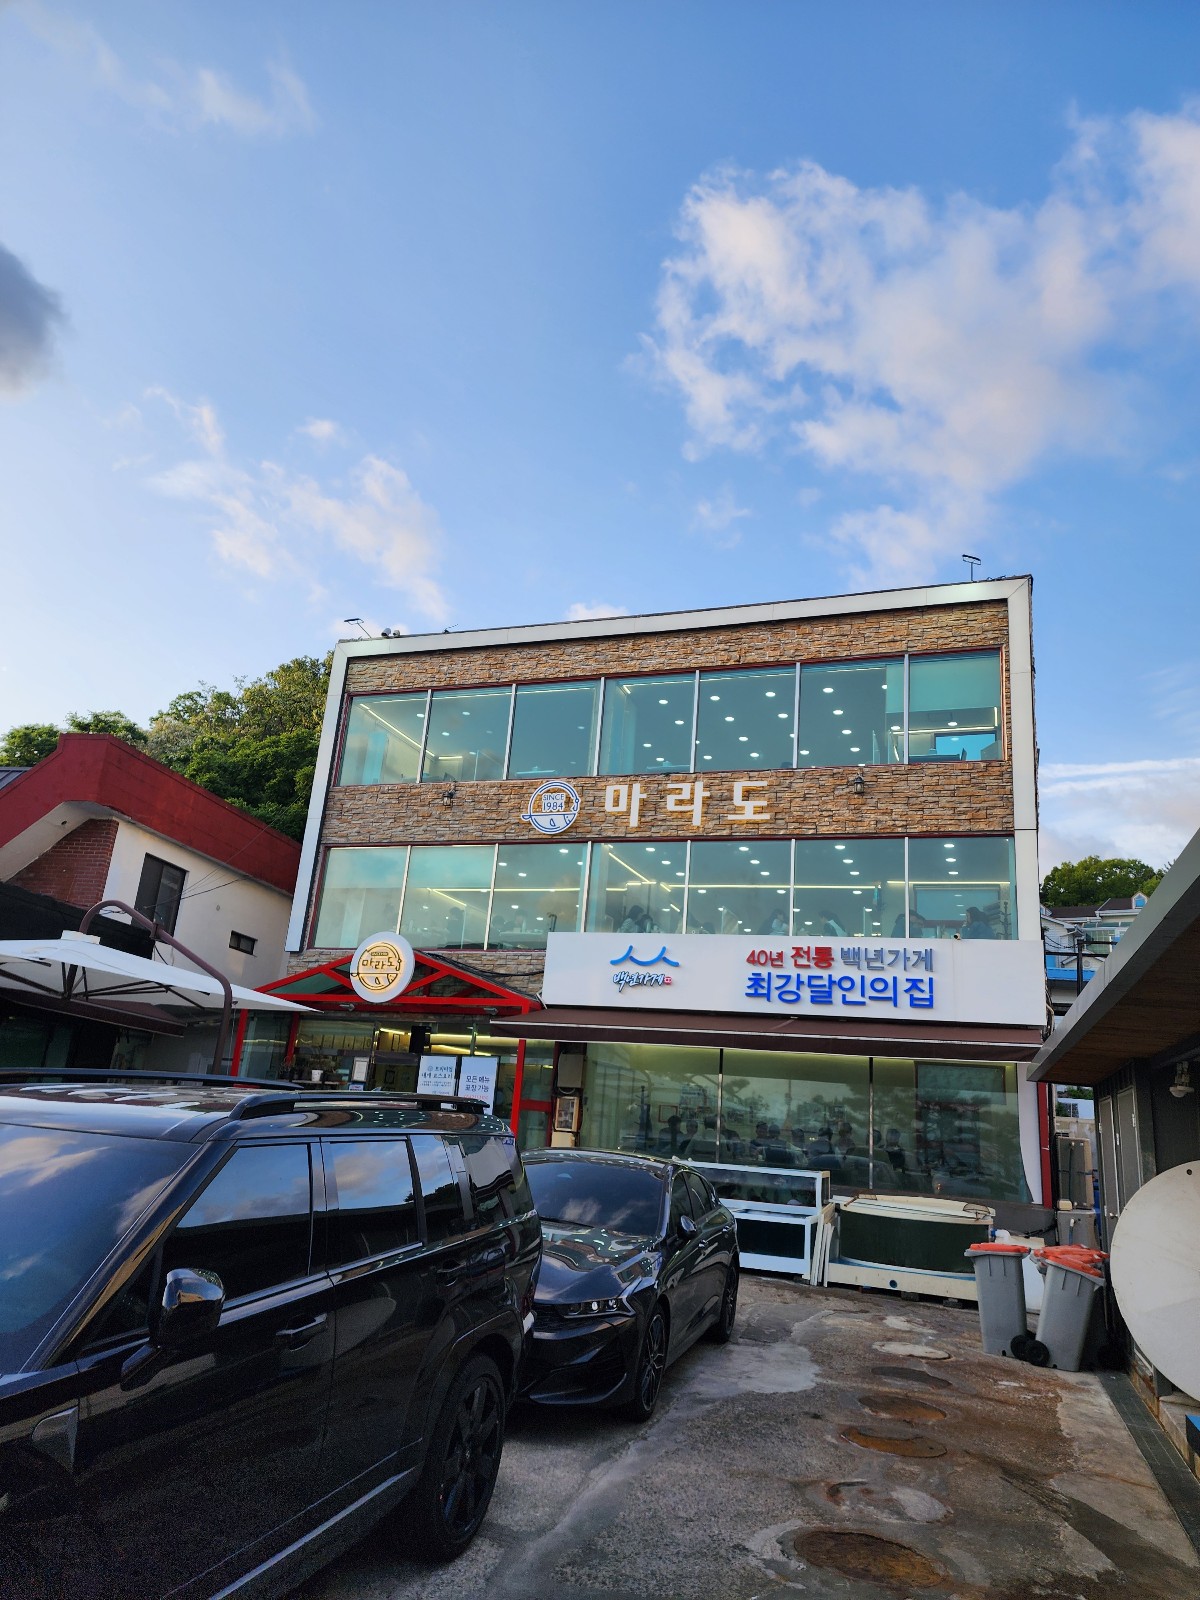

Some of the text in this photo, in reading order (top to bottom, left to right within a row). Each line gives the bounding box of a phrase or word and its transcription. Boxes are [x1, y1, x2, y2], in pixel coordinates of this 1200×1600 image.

[543, 801, 564, 811] 1984
[361, 956, 395, 970] 마라도
[745, 946, 935, 972] 40년 전통 백년가게
[613, 971, 665, 993] 백년가게
[466, 1075, 477, 1083] 모든
[465, 1084, 489, 1093] 포장 가능
